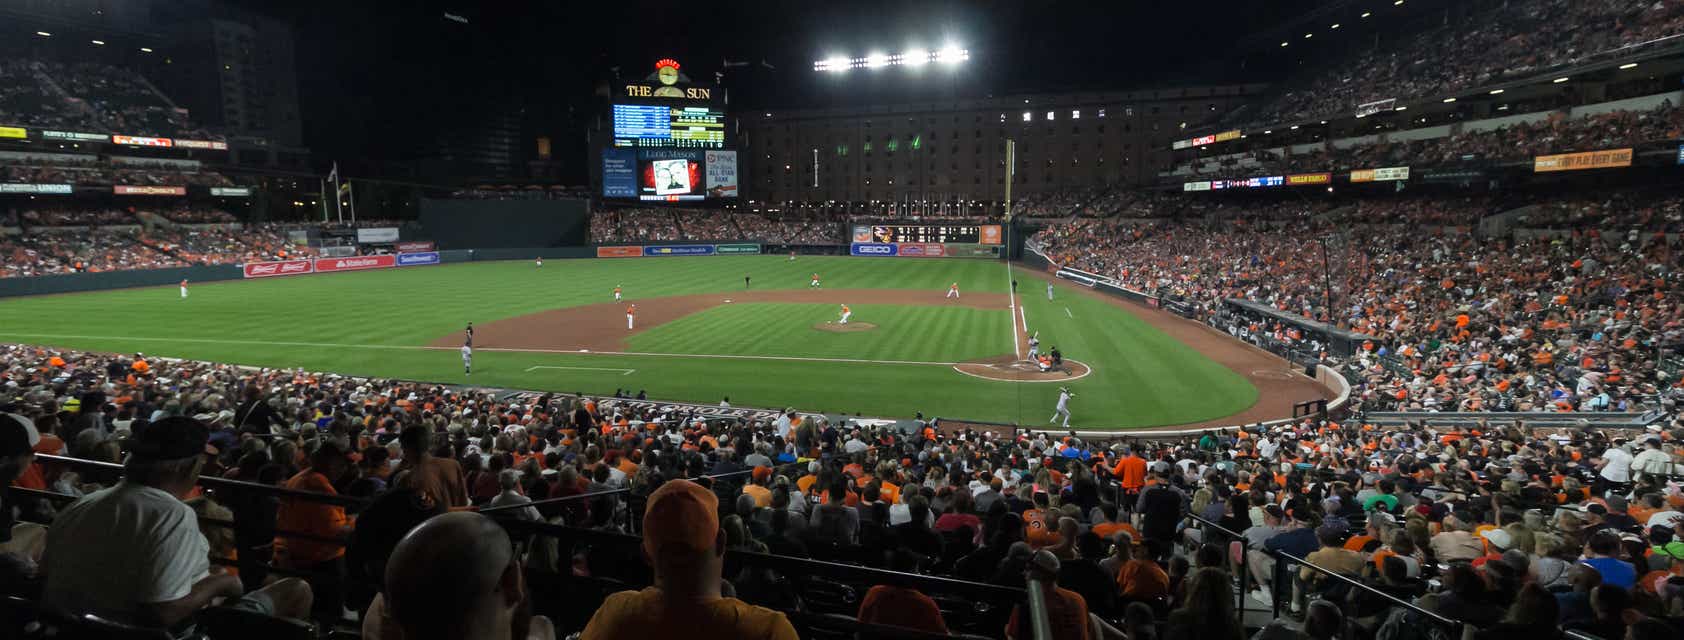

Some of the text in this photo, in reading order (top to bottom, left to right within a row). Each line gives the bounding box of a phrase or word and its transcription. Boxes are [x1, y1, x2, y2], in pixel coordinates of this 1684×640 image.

[626, 85, 710, 99] THE SUN
[37, 184, 72, 194] UNION
[859, 246, 891, 254] GEICO
